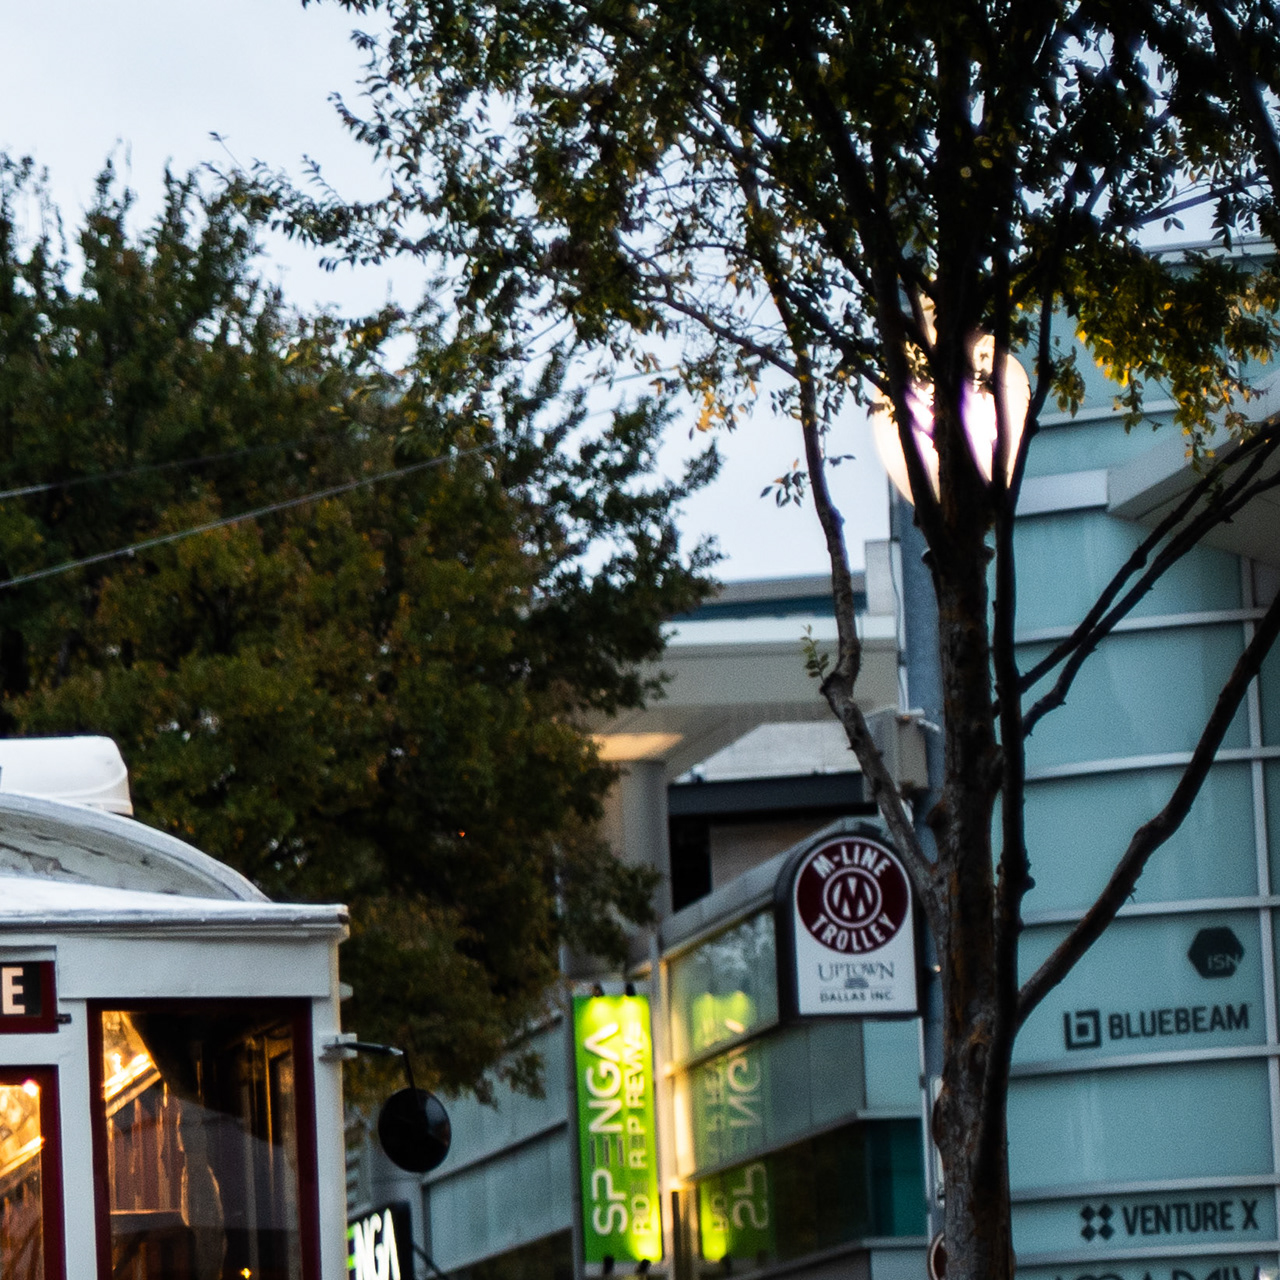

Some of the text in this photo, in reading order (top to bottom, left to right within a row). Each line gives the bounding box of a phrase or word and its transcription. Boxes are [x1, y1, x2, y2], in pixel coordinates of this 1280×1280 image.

[812, 844, 892, 878] M-LINE
[811, 912, 896, 951] TROLLEY
[818, 961, 895, 981] UPTOWN
[1207, 953, 1240, 970] ISN
[819, 991, 866, 1003] DALLAS
[1108, 1003, 1249, 1040] BLUEBEAM
[584, 1021, 628, 1236] SPENGA
[1122, 1199, 1259, 1236] VENTURE X
